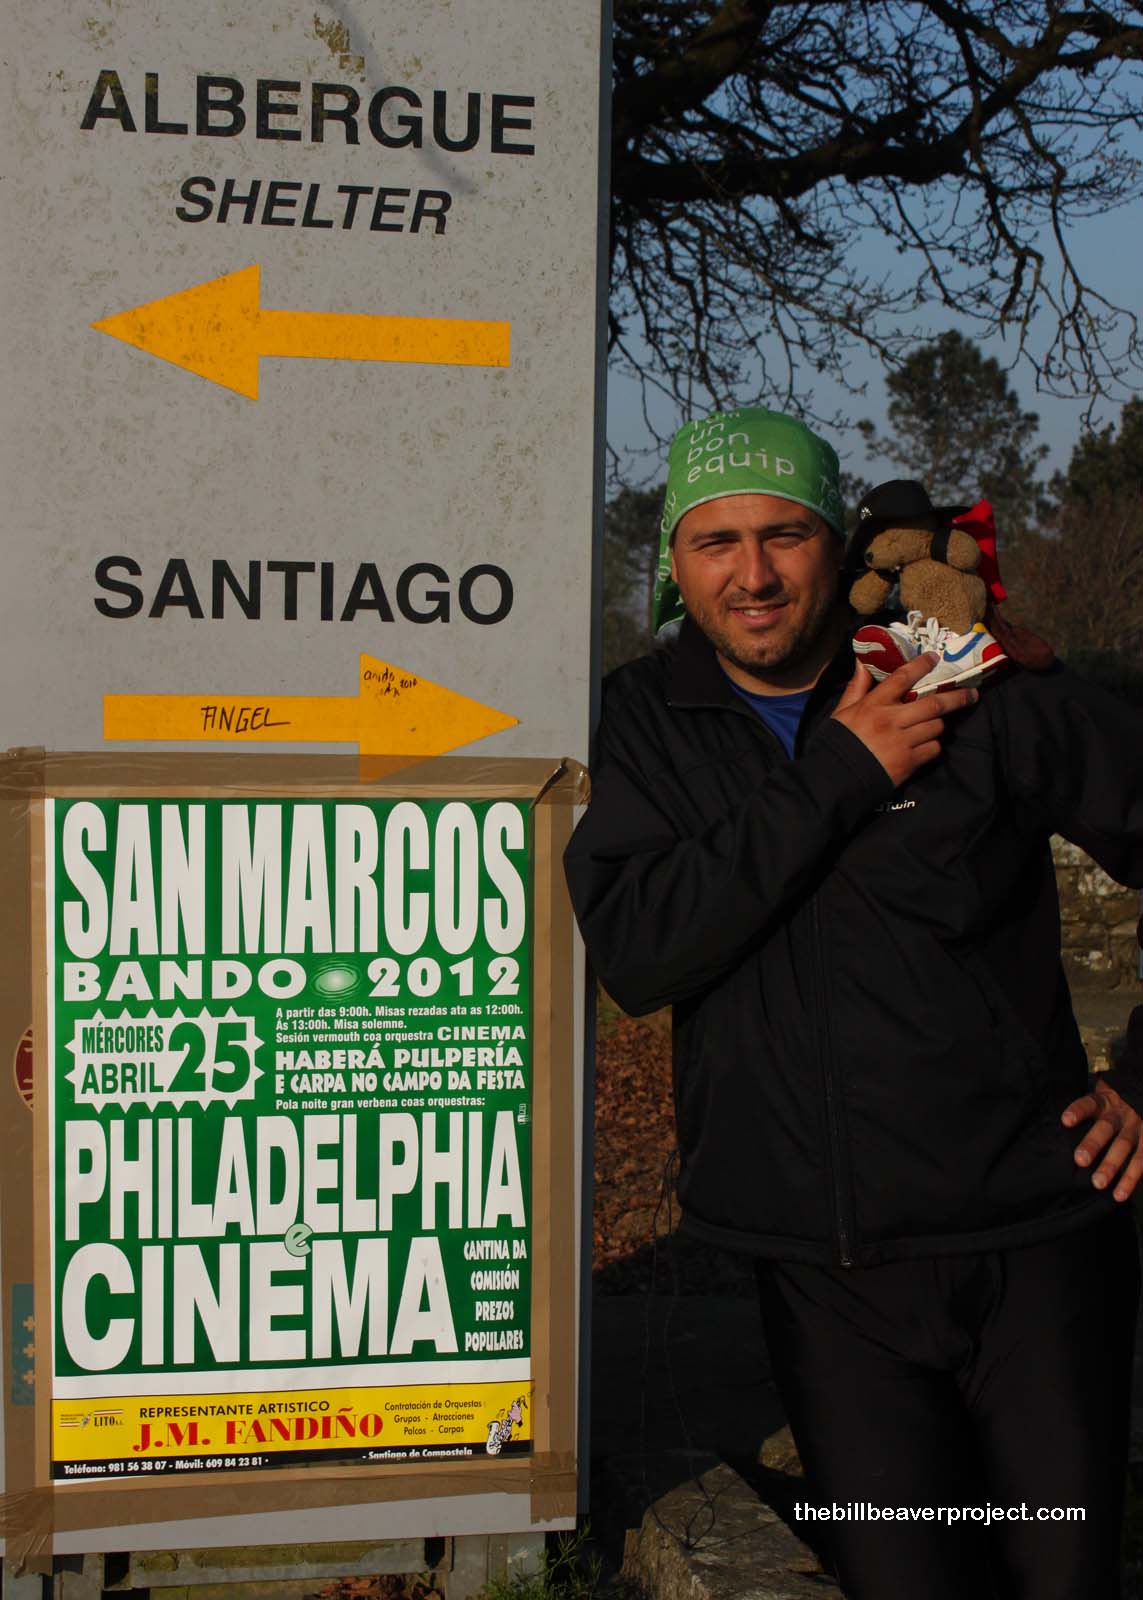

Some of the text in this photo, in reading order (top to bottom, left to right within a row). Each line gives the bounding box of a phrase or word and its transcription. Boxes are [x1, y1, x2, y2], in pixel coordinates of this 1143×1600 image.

[80, 70, 536, 156] ALBERGUE
[175, 176, 452, 236] SHELTER
[690, 421, 724, 445] un
[687, 432, 749, 464] bon
[687, 448, 795, 484] equip
[94, 555, 514, 625] SANTIAGO
[62, 801, 526, 959] SAN MARCOS
[63, 955, 521, 1002] BANDO 2012
[276, 1004, 524, 1020] A partir das 9:00h. Misas rezadas ata as 12:00h.
[276, 1019, 407, 1031] Ás 13:00h. Misa solemne.
[81, 1021, 164, 1054] MÉRCORES
[276, 1025, 526, 1043] Sesión vermouth coa orquestra CINEMA
[80, 1021, 251, 1095] ABRIL 25
[275, 1040, 524, 1071] HABERÁ PULPERÍA
[275, 1069, 526, 1094] E CARPA NO CAMPO DA FESTA
[276, 1096, 485, 1111] Pola noite gran verbena coas orquestras:
[64, 1110, 527, 1241] PHILADELPHIA
[284, 1222, 314, 1257] e
[463, 1239, 527, 1261] CANTINA DA
[470, 1263, 520, 1291] COMISIÓN
[61, 1236, 459, 1371] CINEMA
[475, 1300, 515, 1322] PREZOS
[464, 1328, 524, 1352] POPULARES
[139, 1400, 331, 1419] REPRESENTANTE ARTISTICO
[384, 1399, 482, 1411] Contratación de Orquestas
[132, 1407, 383, 1453] J.M. FANDIÑO
[394, 1414, 421, 1425] Grupos
[432, 1412, 475, 1422] Atracciones
[403, 1426, 426, 1435] Palcos
[438, 1424, 464, 1435] Carpas
[64, 1465, 107, 1475] Teléfono:
[108, 1463, 125, 1472] 981
[127, 1462, 140, 1472] 56
[141, 1462, 153, 1471] 38
[154, 1461, 167, 1470] 07
[175, 1459, 204, 1470] Móvil:
[205, 1458, 222, 1468] 609
[224, 1458, 236, 1467] 84
[237, 1457, 250, 1467] 23
[251, 1456, 263, 1466] 81
[368, 1450, 407, 1460] Santiago
[409, 1450, 420, 1458] de
[422, 1448, 473, 1457] Compostela
